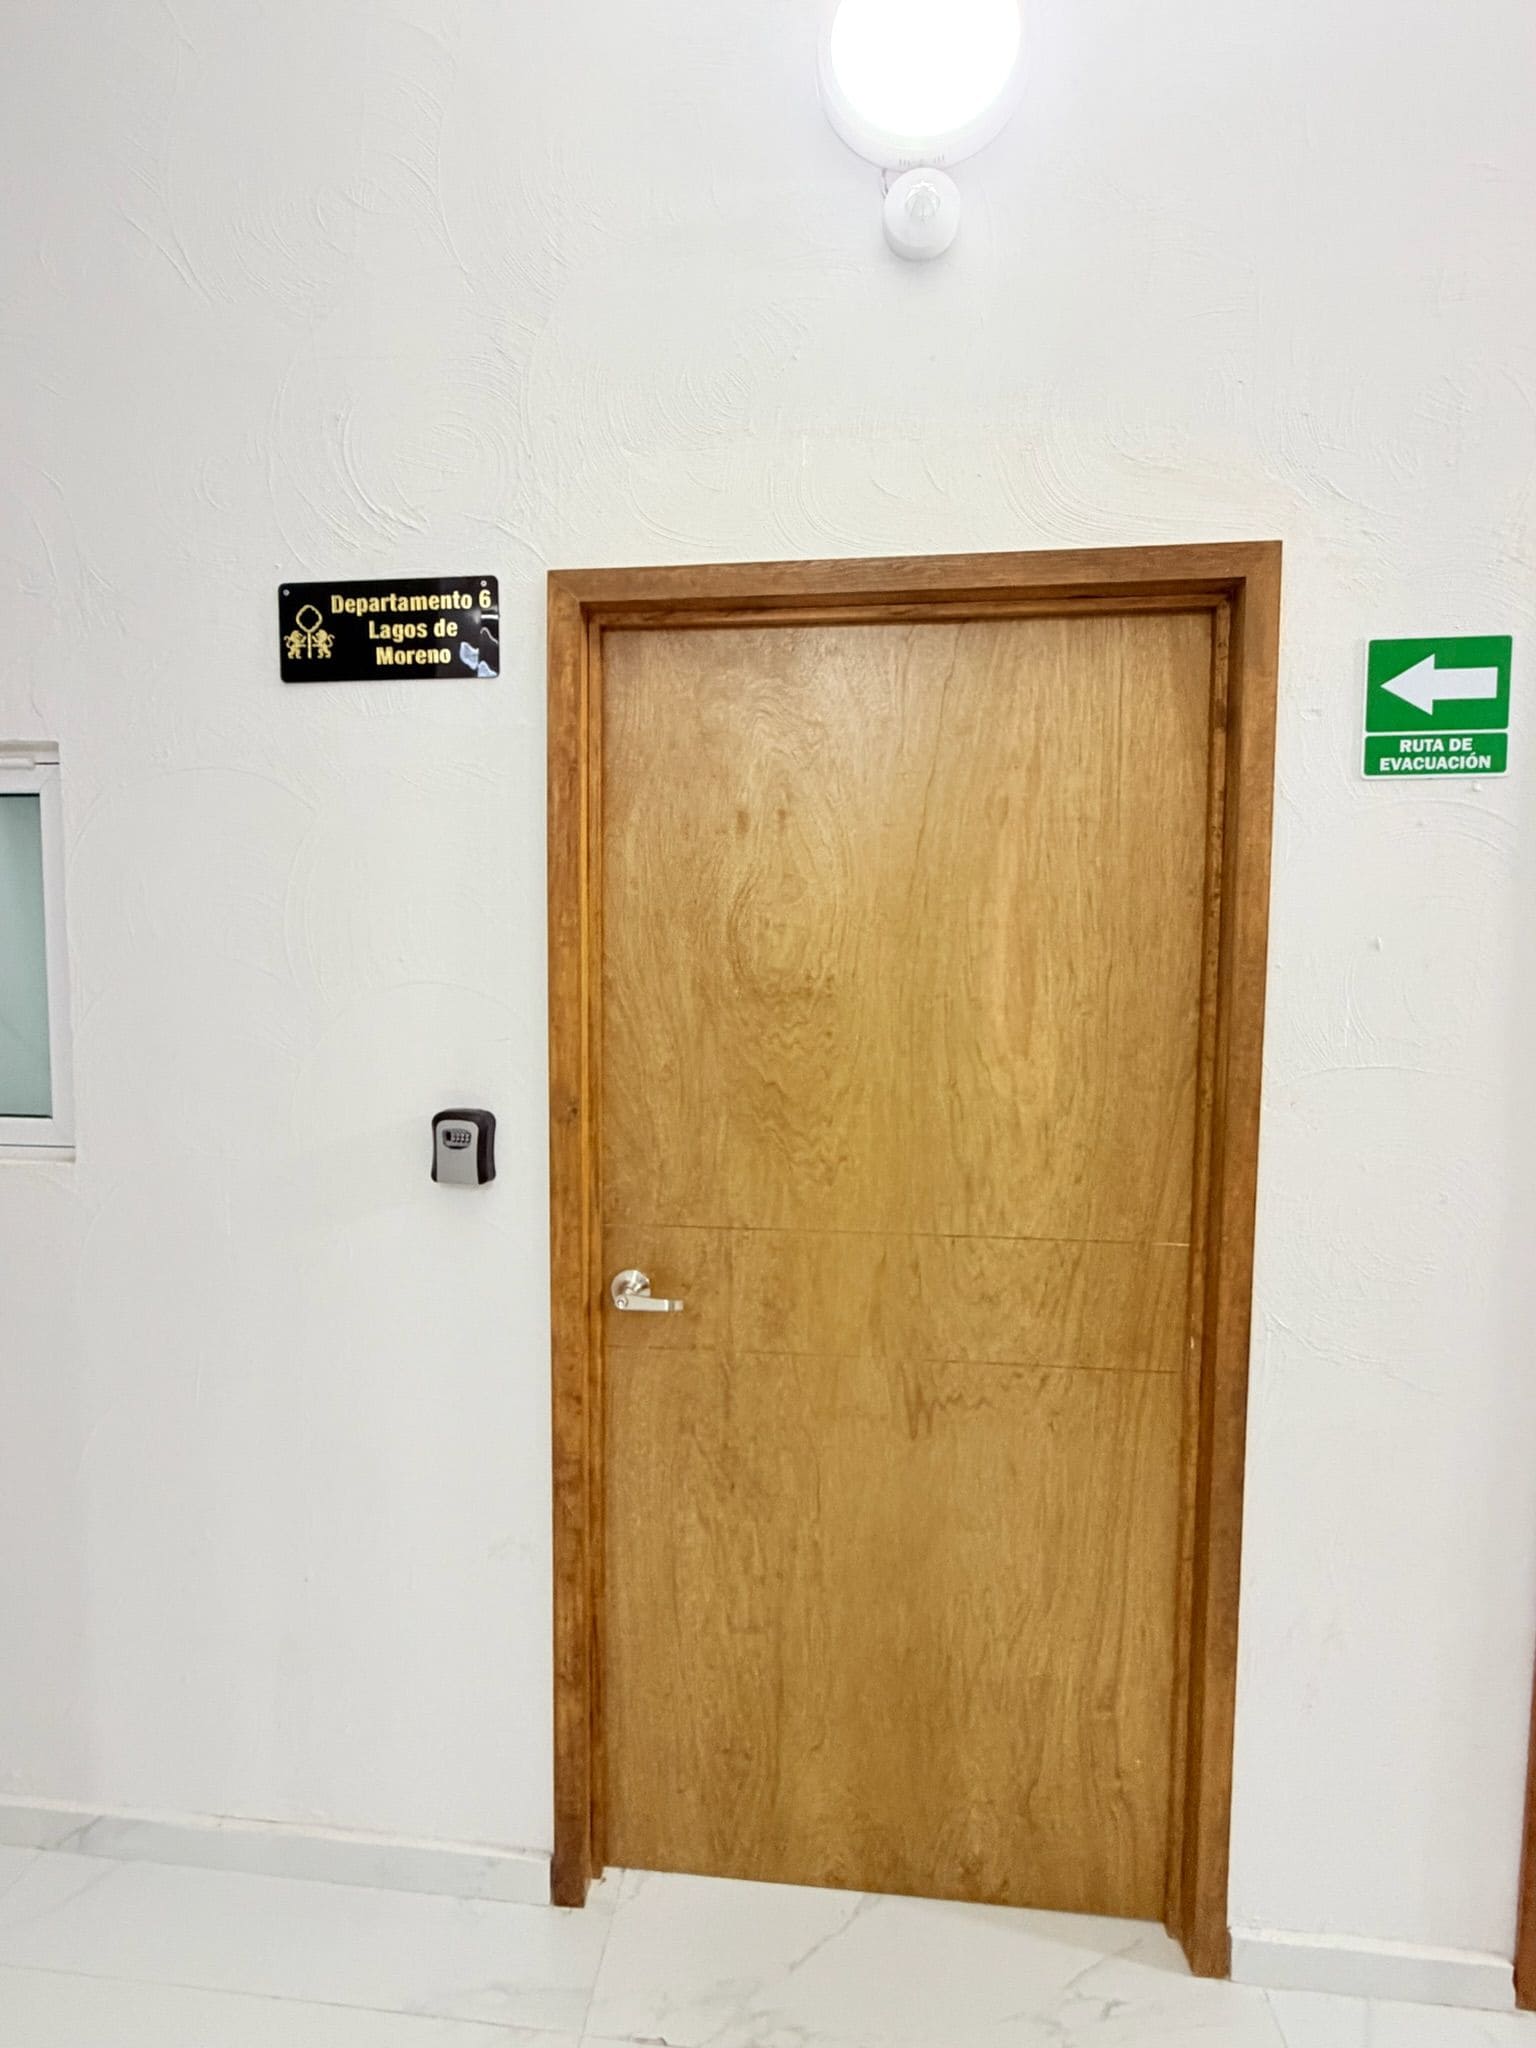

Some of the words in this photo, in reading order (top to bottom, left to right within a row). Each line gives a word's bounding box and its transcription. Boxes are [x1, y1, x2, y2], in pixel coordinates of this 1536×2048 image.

[330, 590, 473, 616] Departamento
[479, 589, 492, 609] 6
[368, 620, 428, 643] Lagos
[433, 618, 458, 638] de
[376, 646, 452, 665] Moreno
[1399, 738, 1444, 753] RUTA
[1449, 738, 1473, 752] DE
[1379, 752, 1492, 771] EVACUACIÓN
